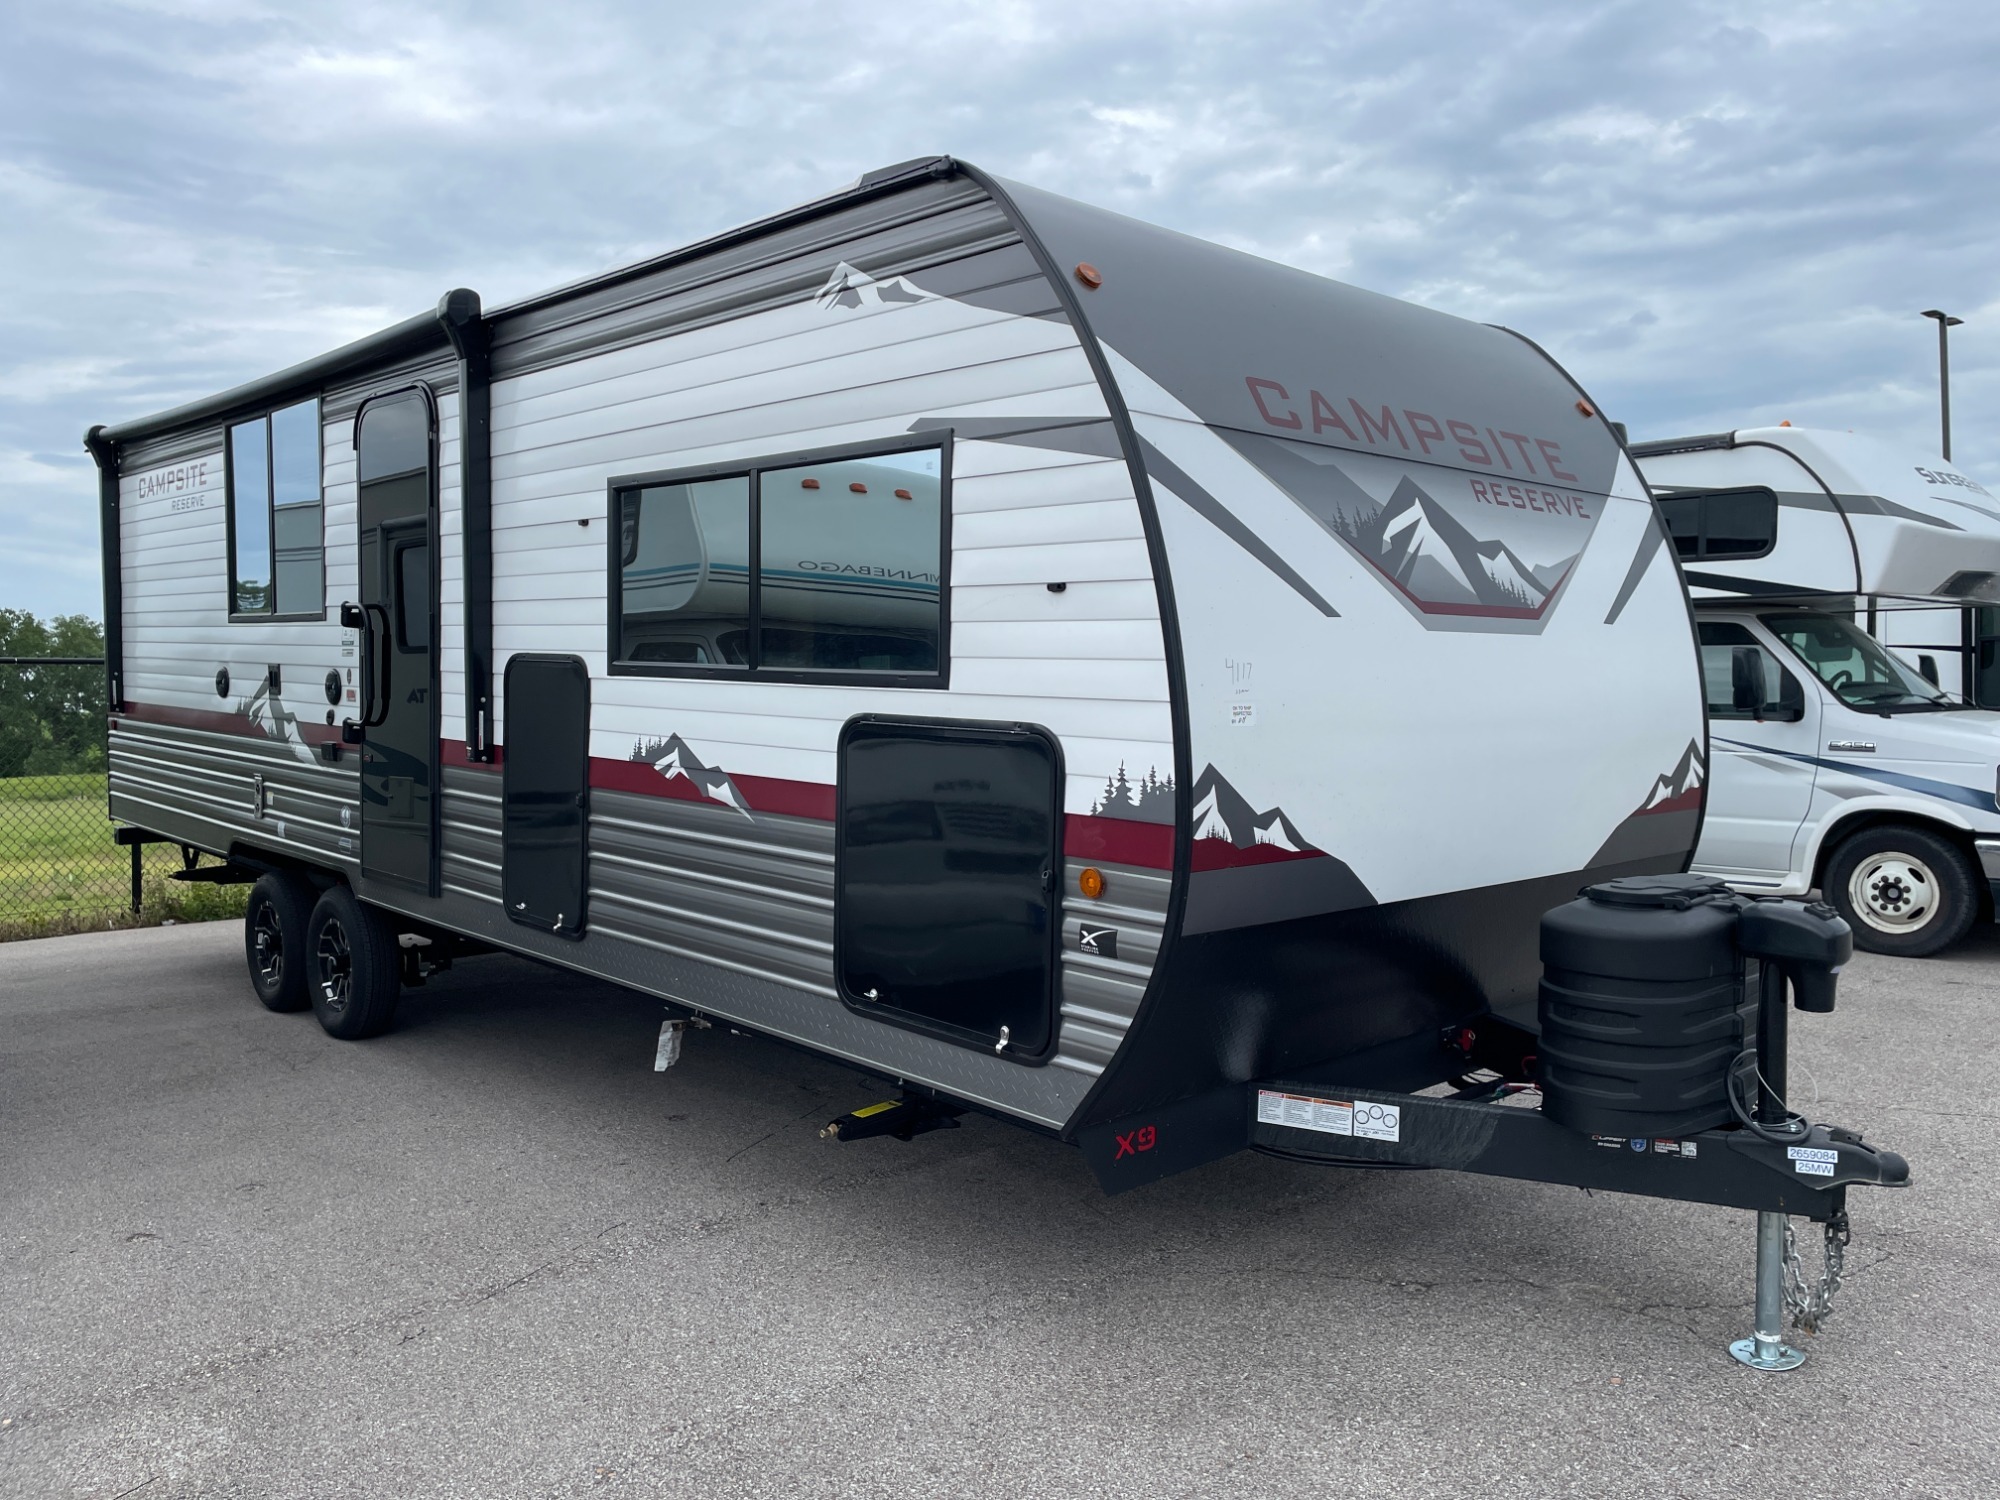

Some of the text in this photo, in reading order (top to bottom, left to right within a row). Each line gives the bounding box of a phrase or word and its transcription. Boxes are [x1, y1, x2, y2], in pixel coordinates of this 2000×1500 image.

[1245, 376, 1579, 483] CAMPSITE
[138, 462, 208, 499] CAMPSITE
[171, 494, 205, 511] RESERVE
[1469, 479, 1591, 520] RESERVE
[1115, 1125, 1156, 1160] X9
[1790, 1148, 1837, 1161] 2659084
[1798, 1162, 1832, 1174] 25MW
